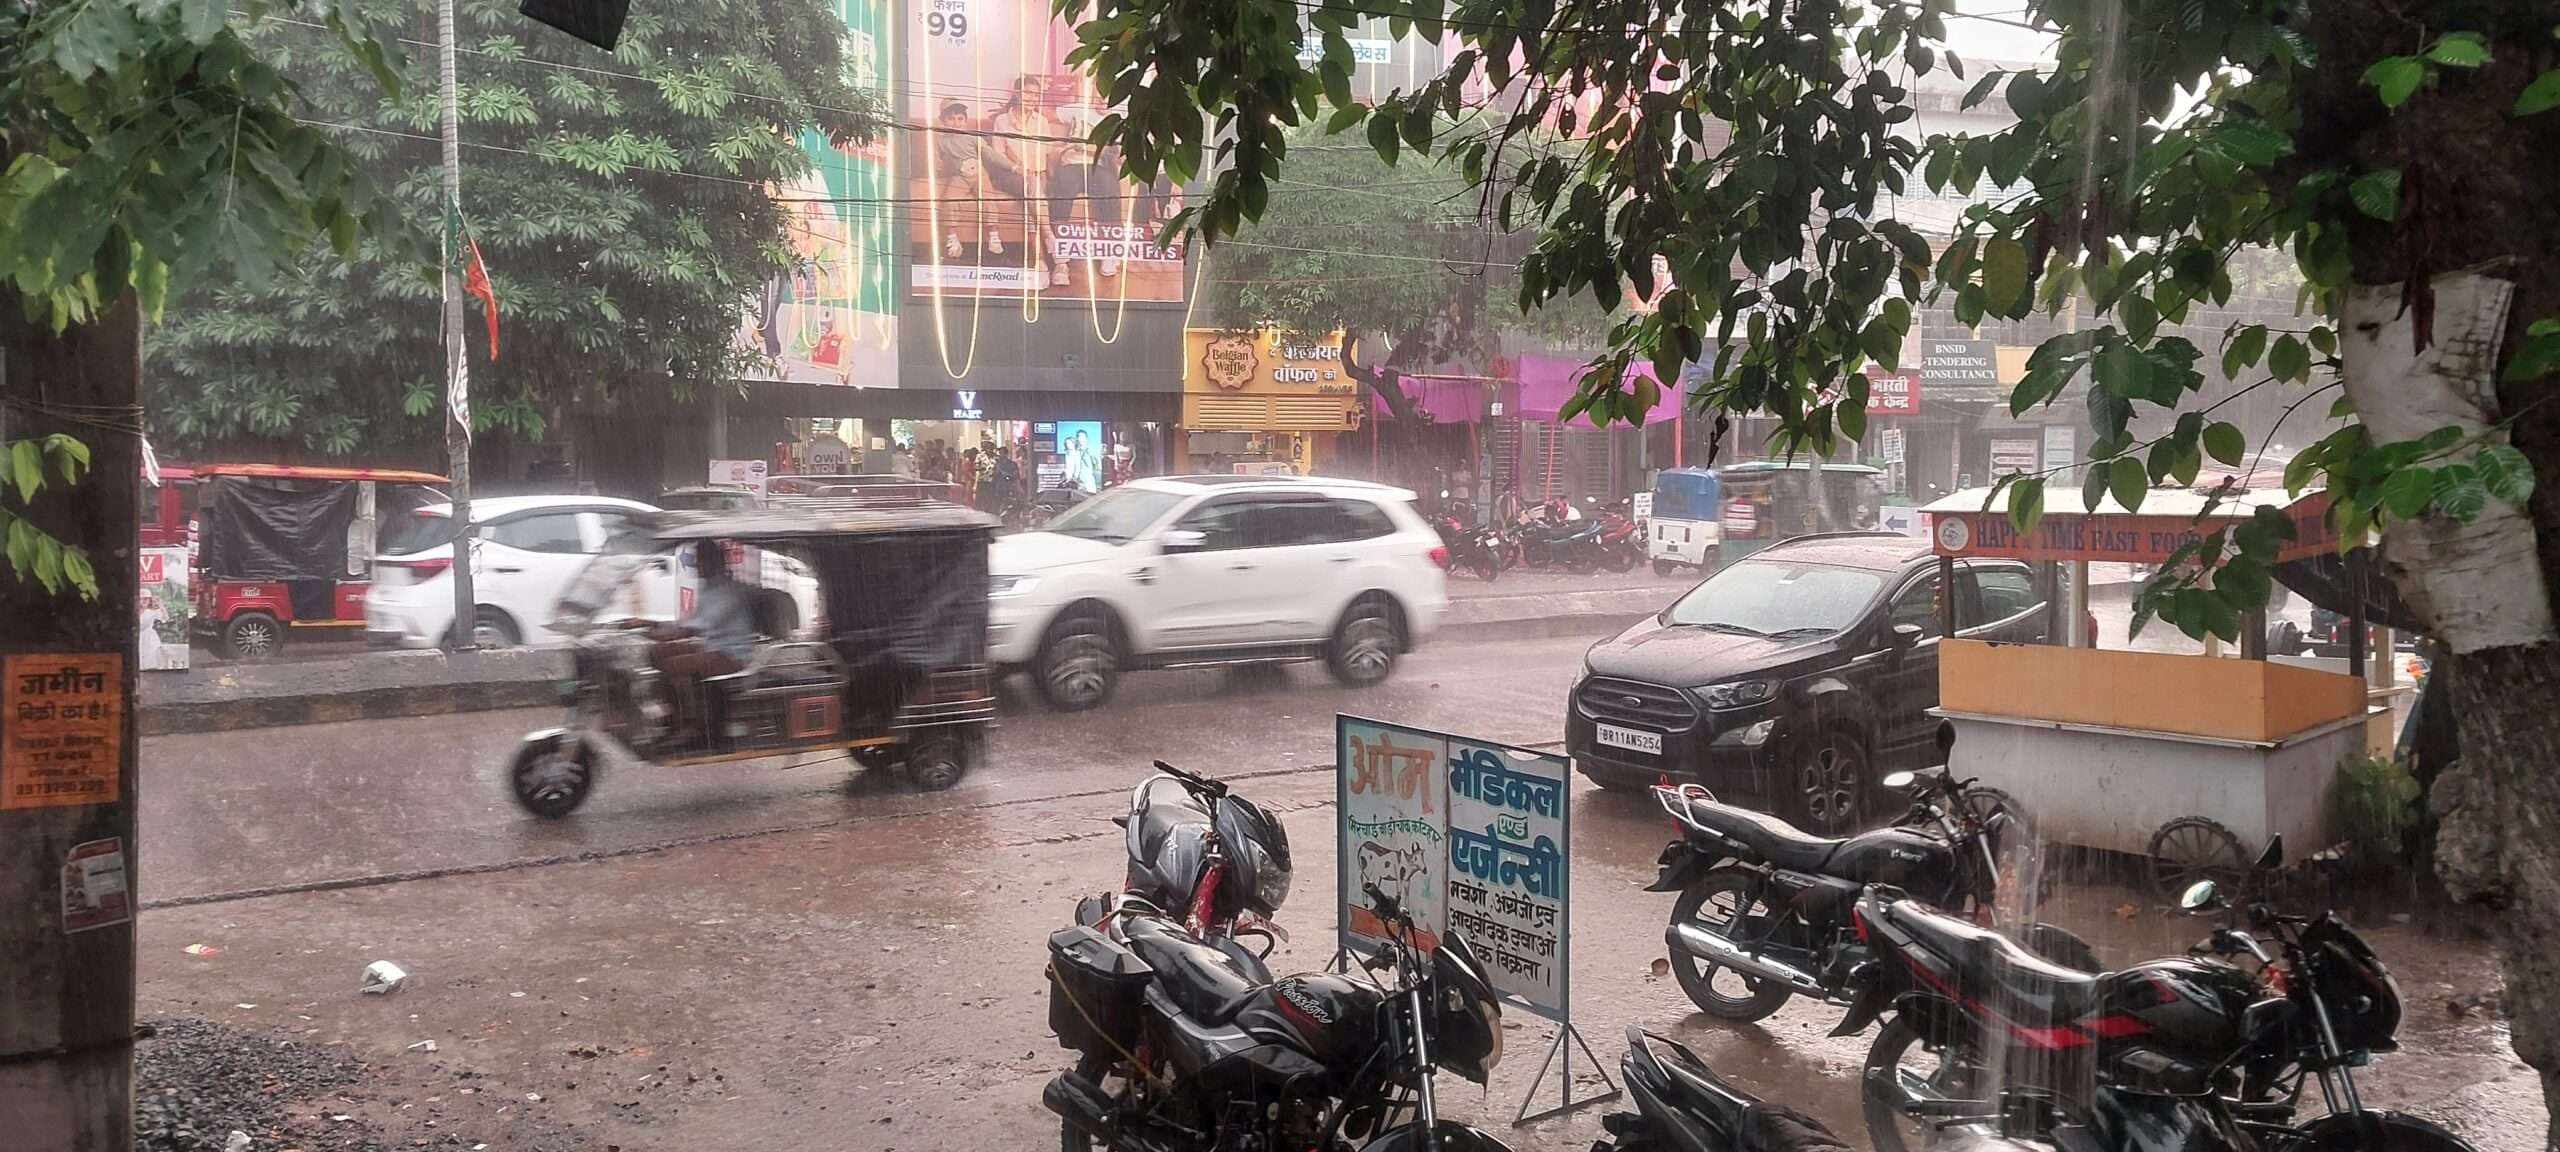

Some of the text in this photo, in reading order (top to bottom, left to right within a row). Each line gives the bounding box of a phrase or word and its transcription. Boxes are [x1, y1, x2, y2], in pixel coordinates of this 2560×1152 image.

[1057, 225, 1144, 240] OWN YOUR
[1057, 241, 1141, 258] FASHION
[1213, 350, 1249, 362] Belgian
[1215, 361, 1247, 376] Waffle
[1920, 370, 1997, 379] CONSULTANCY
[958, 391, 977, 409] V
[2091, 529, 2140, 553] FAST
[18, 667, 106, 695] जमीन
[1449, 748, 1562, 819] मेडिकल
[1510, 928, 1557, 959] दवाओं
